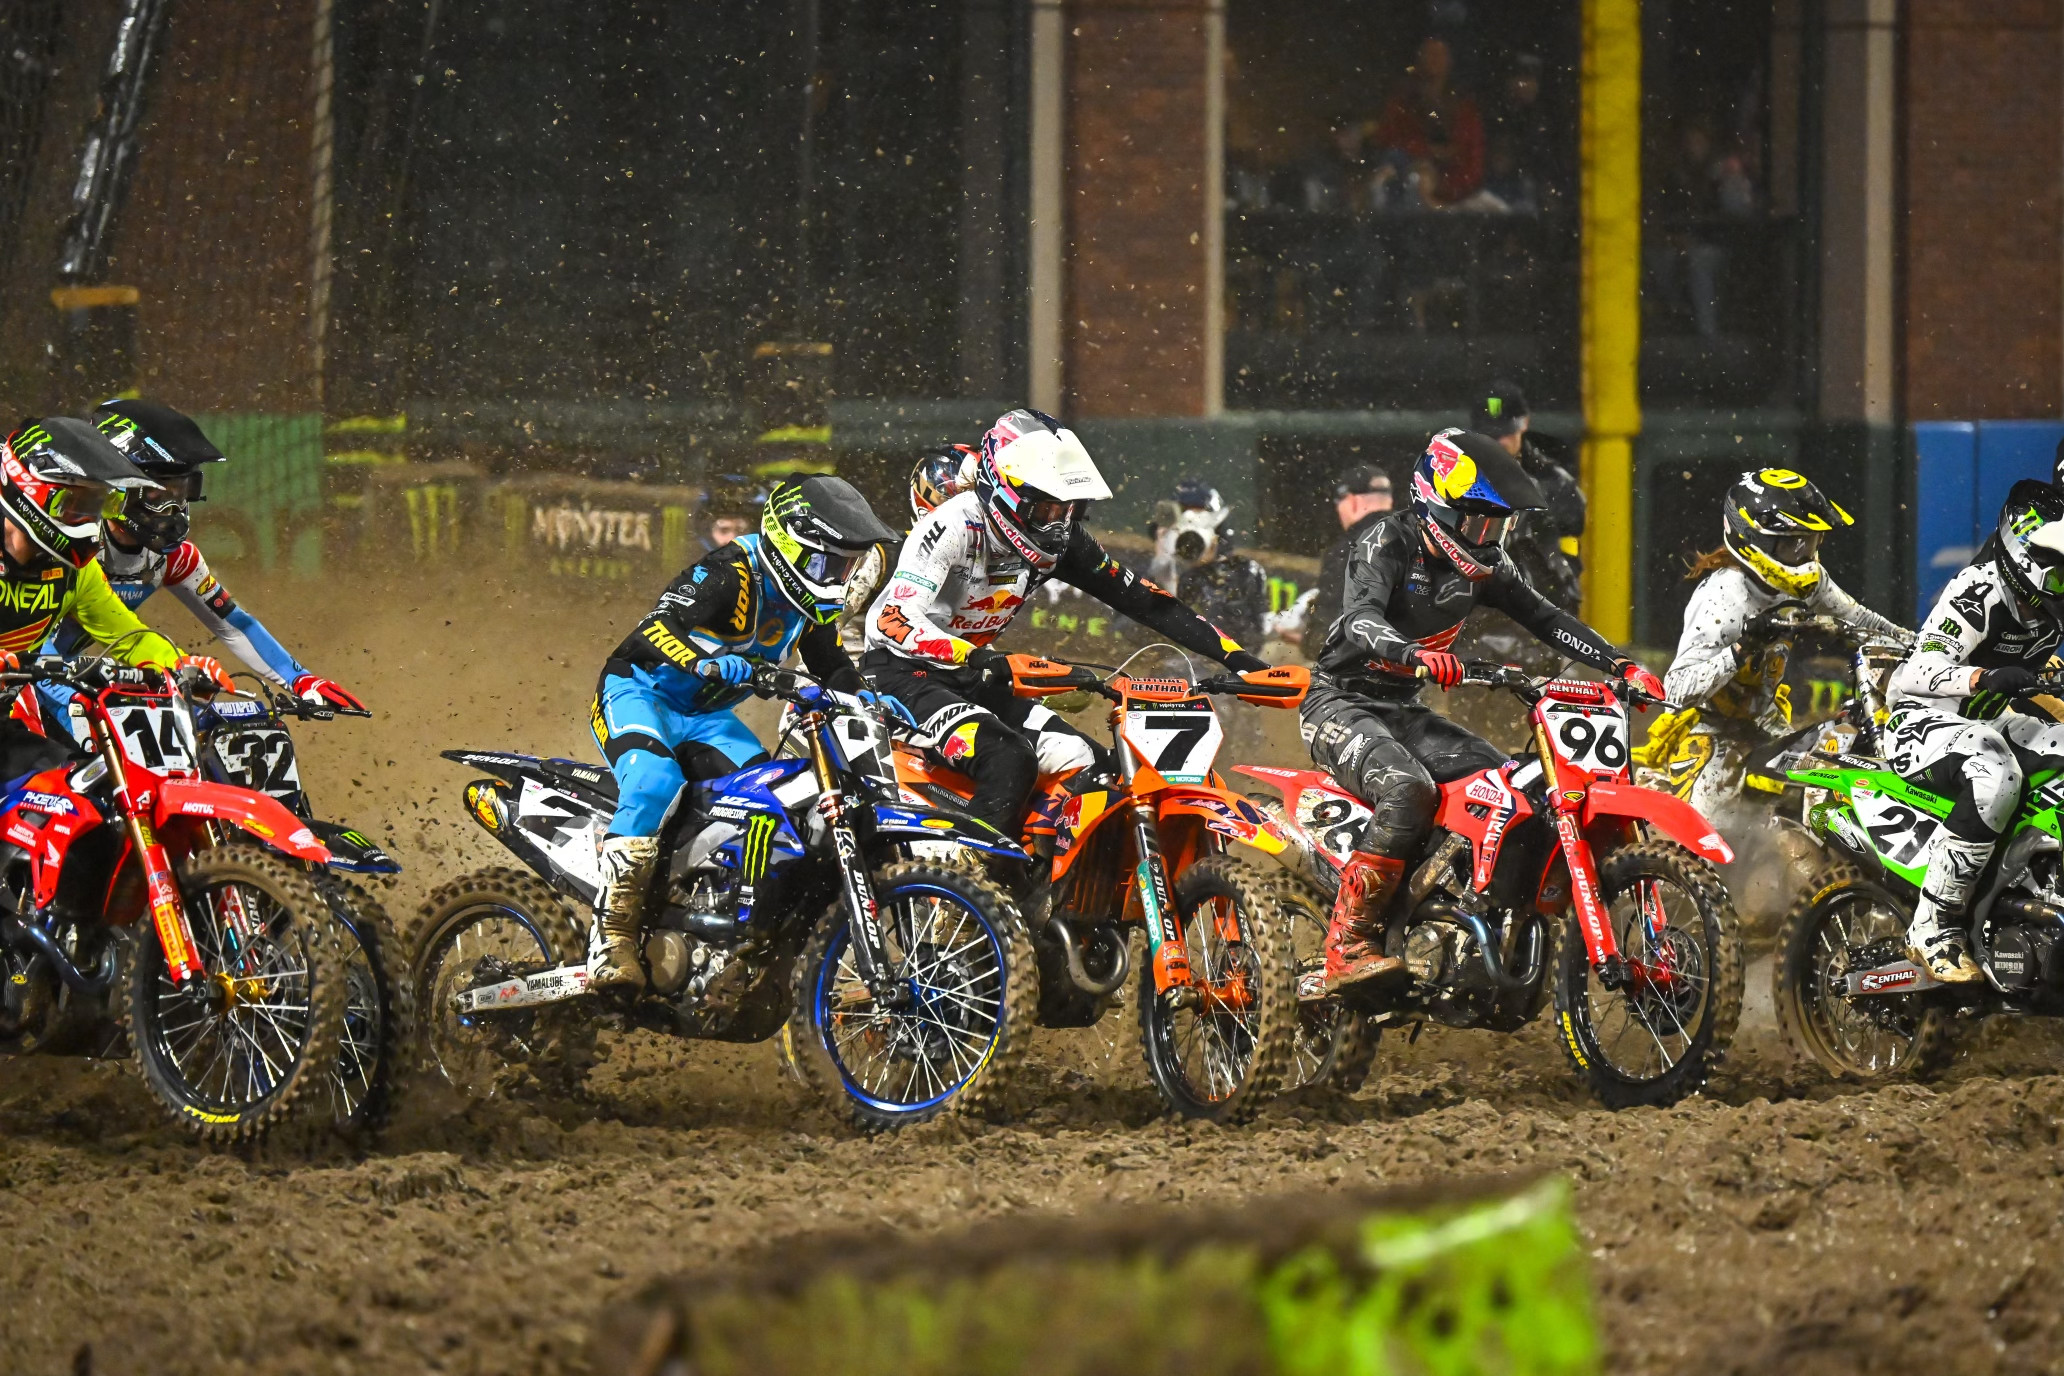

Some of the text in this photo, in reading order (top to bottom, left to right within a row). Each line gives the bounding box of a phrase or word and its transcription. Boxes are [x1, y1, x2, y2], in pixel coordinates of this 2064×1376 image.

[15, 496, 55, 538] MONSTER
[991, 510, 1016, 538] Red
[1012, 534, 1041, 564] Bull
[1427, 521, 1478, 577] Red Bull
[770, 551, 803, 595] MONSTER
[902, 573, 937, 592] MOTOREX
[730, 560, 751, 632] THOR
[642, 619, 698, 668] THOR
[1551, 627, 1601, 661] HONDA
[1028, 661, 1049, 669] KTM
[1267, 671, 1291, 679] KTM
[1130, 683, 1185, 693] RENTHAL
[1549, 684, 1596, 696] RENTHAL
[929, 703, 977, 740] THOR
[1144, 715, 1211, 772] 7
[1559, 717, 1627, 768] 96
[228, 732, 298, 793] 32
[462, 754, 520, 766] DUNLOP
[1838, 753, 1878, 771] DUNLOP
[570, 767, 602, 784] YAMAHA
[1252, 766, 1299, 778] DUNLOP
[1808, 771, 1840, 780] DUNLOP
[1469, 784, 1505, 805] HONDA
[1905, 784, 1938, 804] Kawasaki
[182, 801, 214, 814] MOTUL
[708, 805, 749, 821] PROGRESSIVE
[1867, 805, 1940, 866] 21
[853, 869, 881, 949] DUNLOP
[1574, 866, 1604, 941] DUNLOP
[1141, 889, 1161, 945] MOTOREX
[1994, 950, 2024, 959] Kawasaki
[526, 975, 564, 992] YAMALUBE
